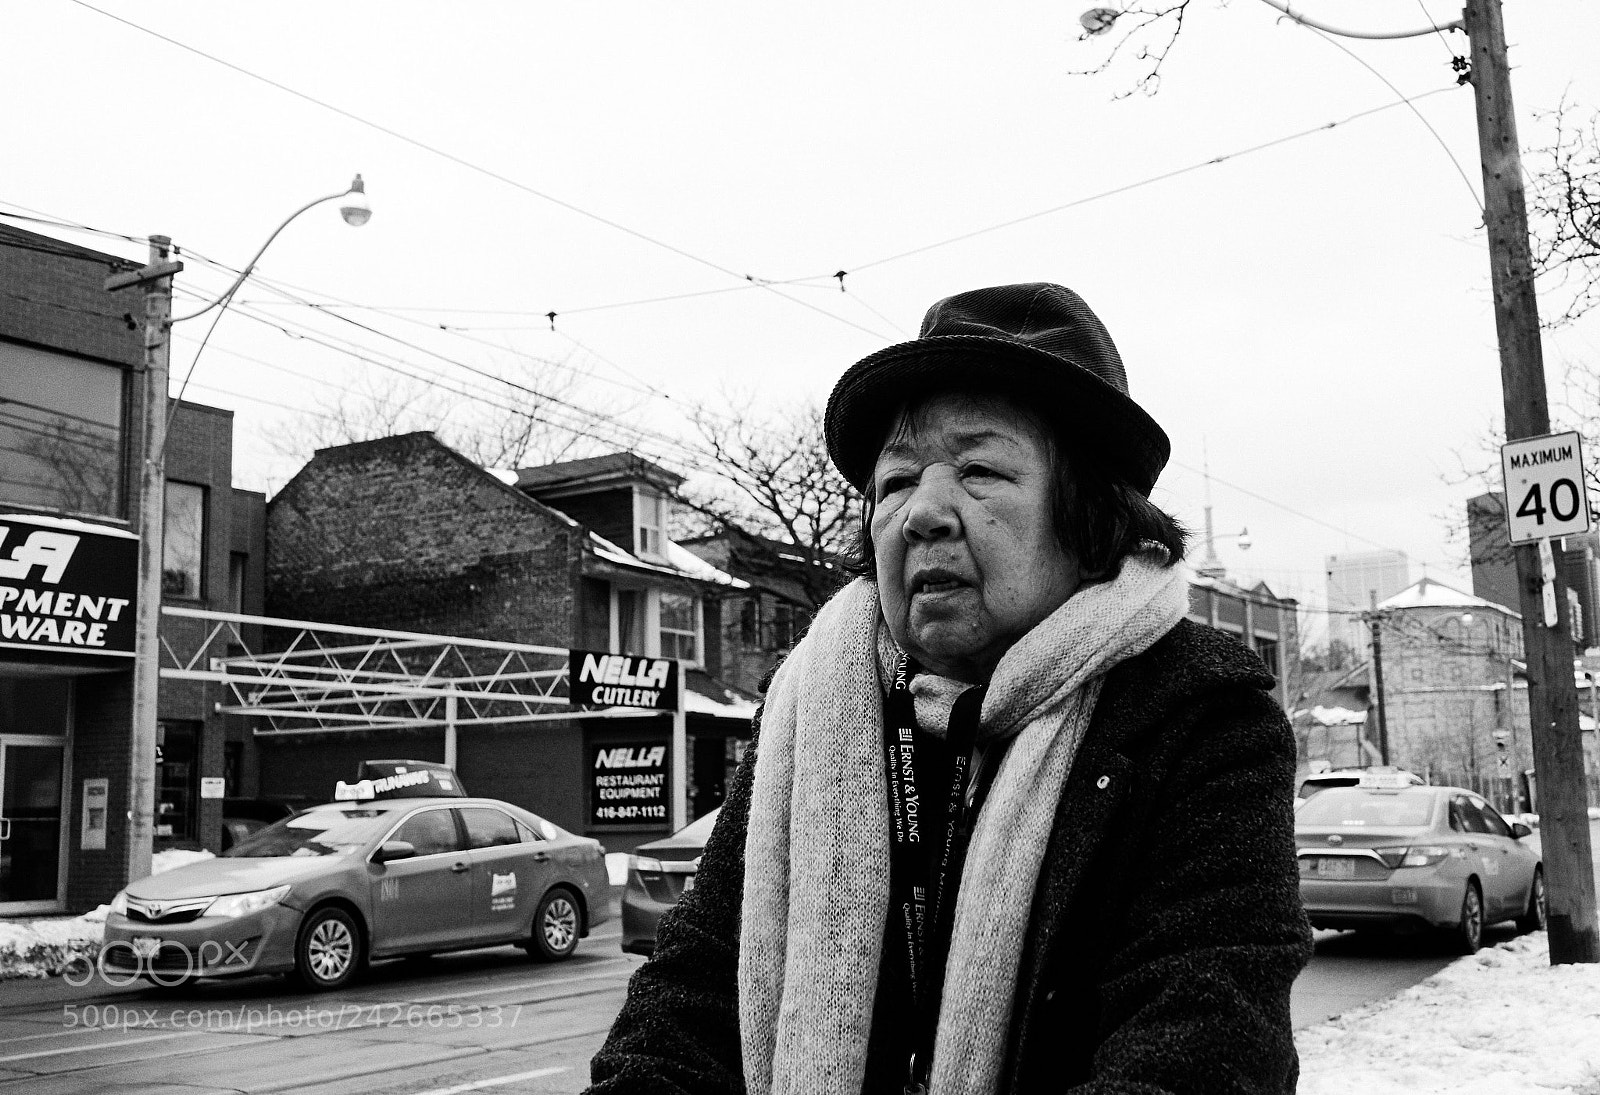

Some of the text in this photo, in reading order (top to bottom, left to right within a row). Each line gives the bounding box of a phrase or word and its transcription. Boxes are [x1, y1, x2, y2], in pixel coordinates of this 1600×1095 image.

[1510, 445, 1573, 470] MAXIMUM
[1515, 478, 1580, 525] 40
[0, 614, 108, 647] WARE
[579, 653, 670, 689] NELLA
[591, 686, 660, 707] CUTLERY
[595, 746, 666, 769] NELLA
[889, 745, 897, 770] Quality
[595, 774, 665, 787] RESTAURANT
[950, 756, 966, 796] Ernst
[599, 787, 661, 800] EQUIPMENT
[892, 780, 902, 816] Everything
[900, 745, 920, 843] ERNST & YOUNG
[896, 817, 903, 830] We
[897, 831, 904, 843] Do
